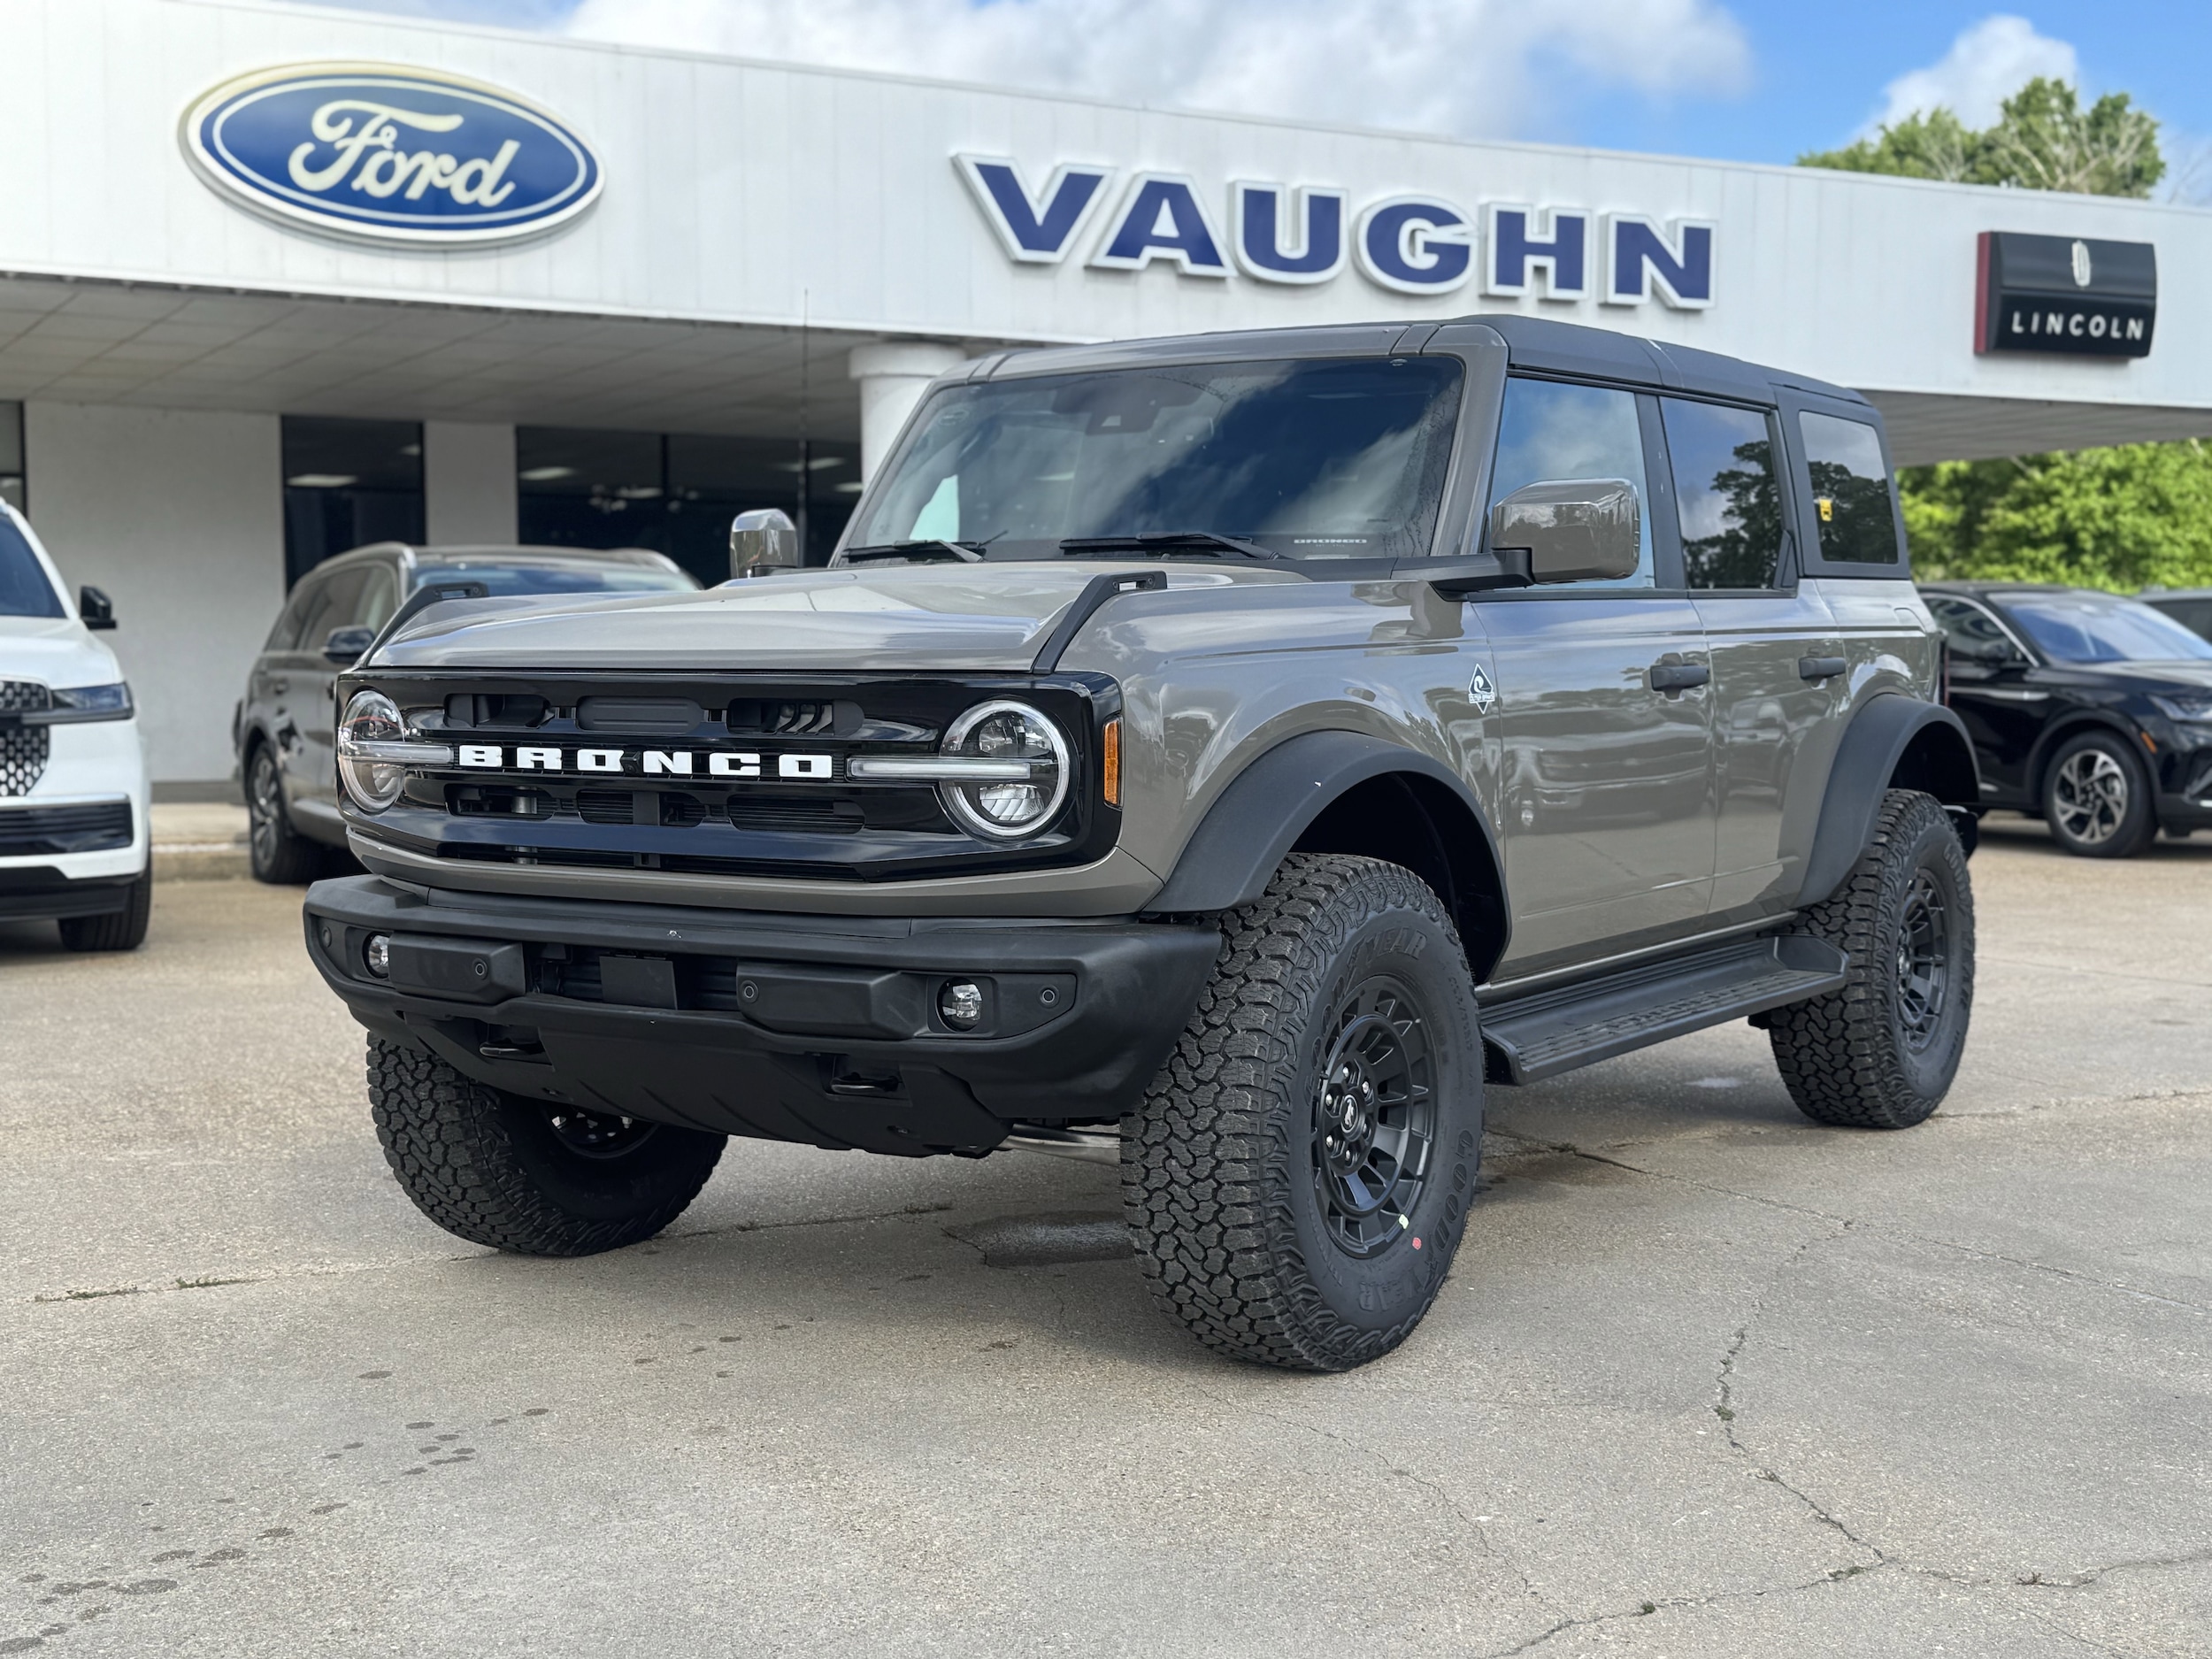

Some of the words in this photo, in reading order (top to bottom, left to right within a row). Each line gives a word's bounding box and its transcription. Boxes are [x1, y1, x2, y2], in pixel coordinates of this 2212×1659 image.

[288, 98, 521, 209] Ford
[957, 157, 1717, 310] VAUGHN
[2011, 311, 2144, 341] LINCOLN
[458, 744, 833, 778] BRONCO
